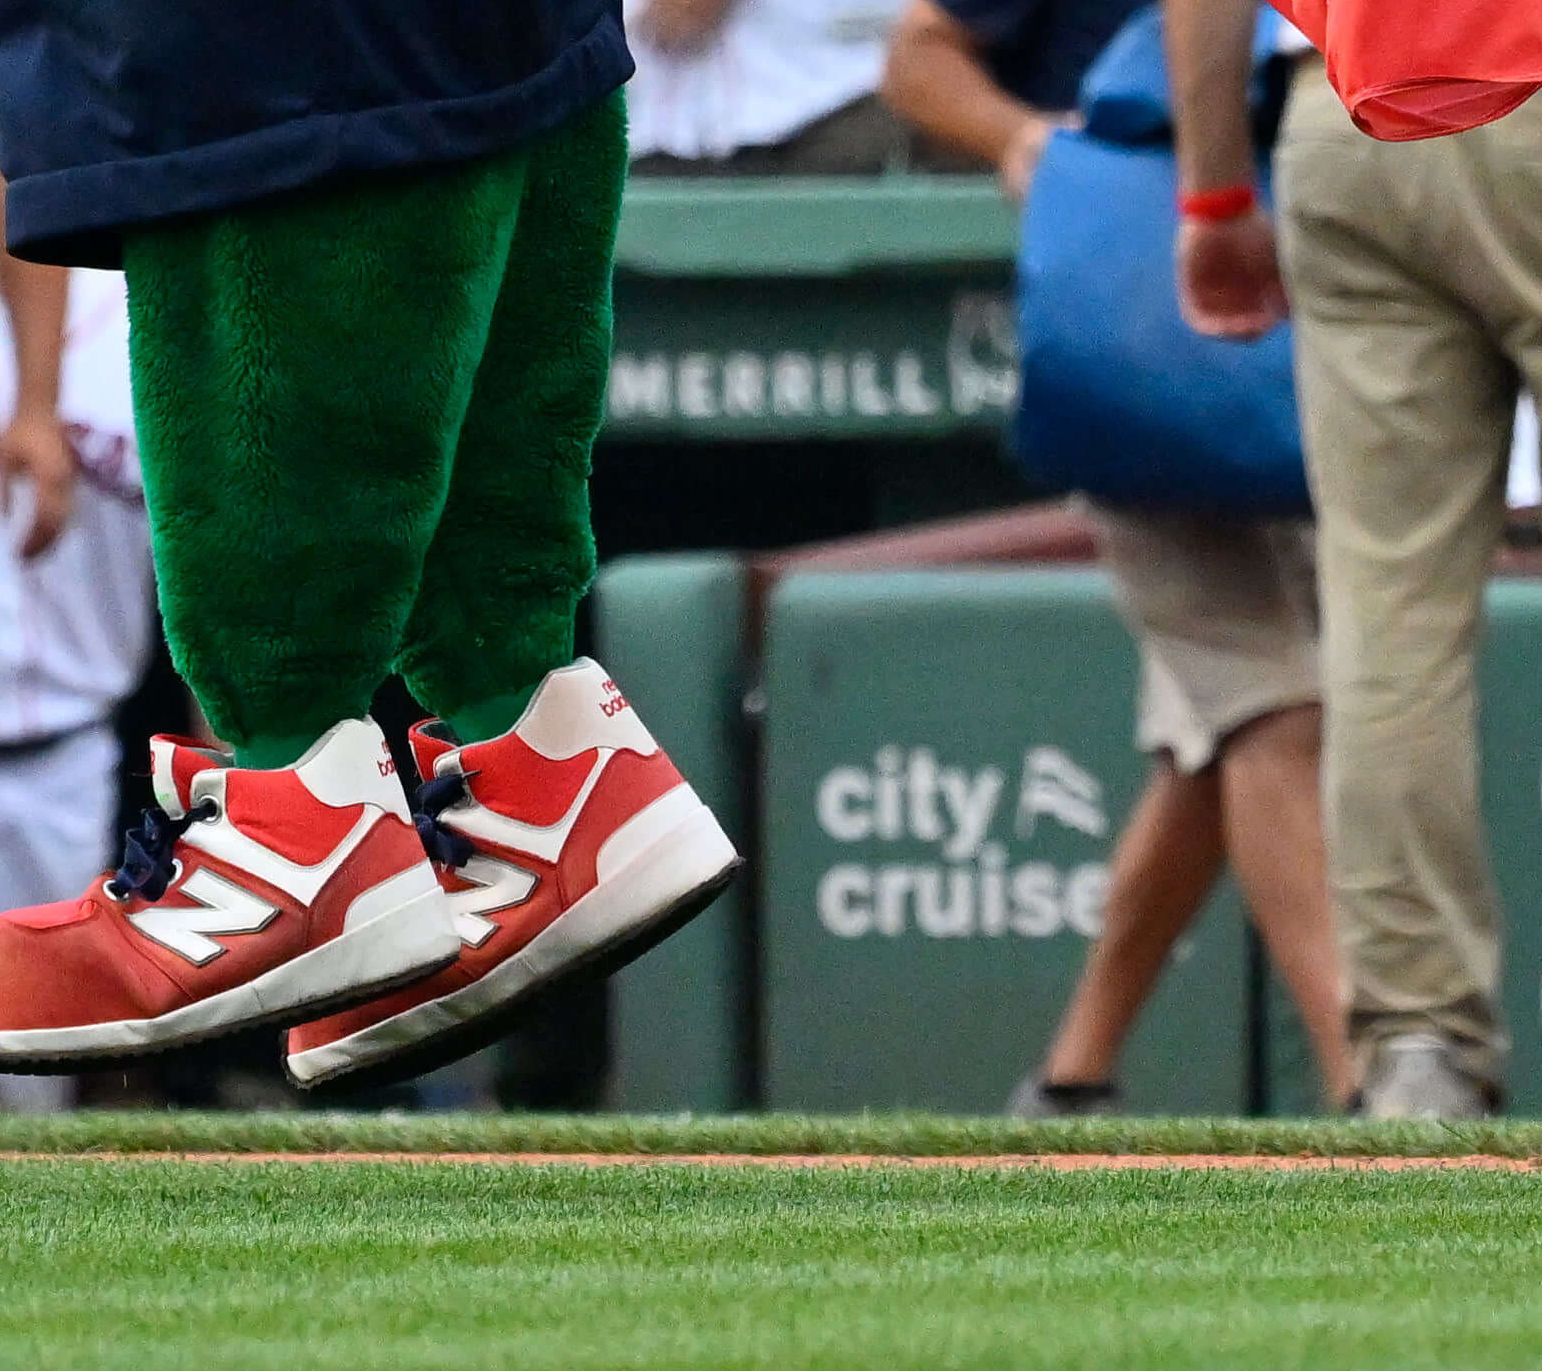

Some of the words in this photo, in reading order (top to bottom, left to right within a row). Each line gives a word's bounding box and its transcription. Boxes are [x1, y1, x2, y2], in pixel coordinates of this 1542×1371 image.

[611, 352, 942, 418] MERRILL
[818, 744, 1006, 858] city
[127, 867, 279, 966] N
[818, 844, 1114, 939] cruise
